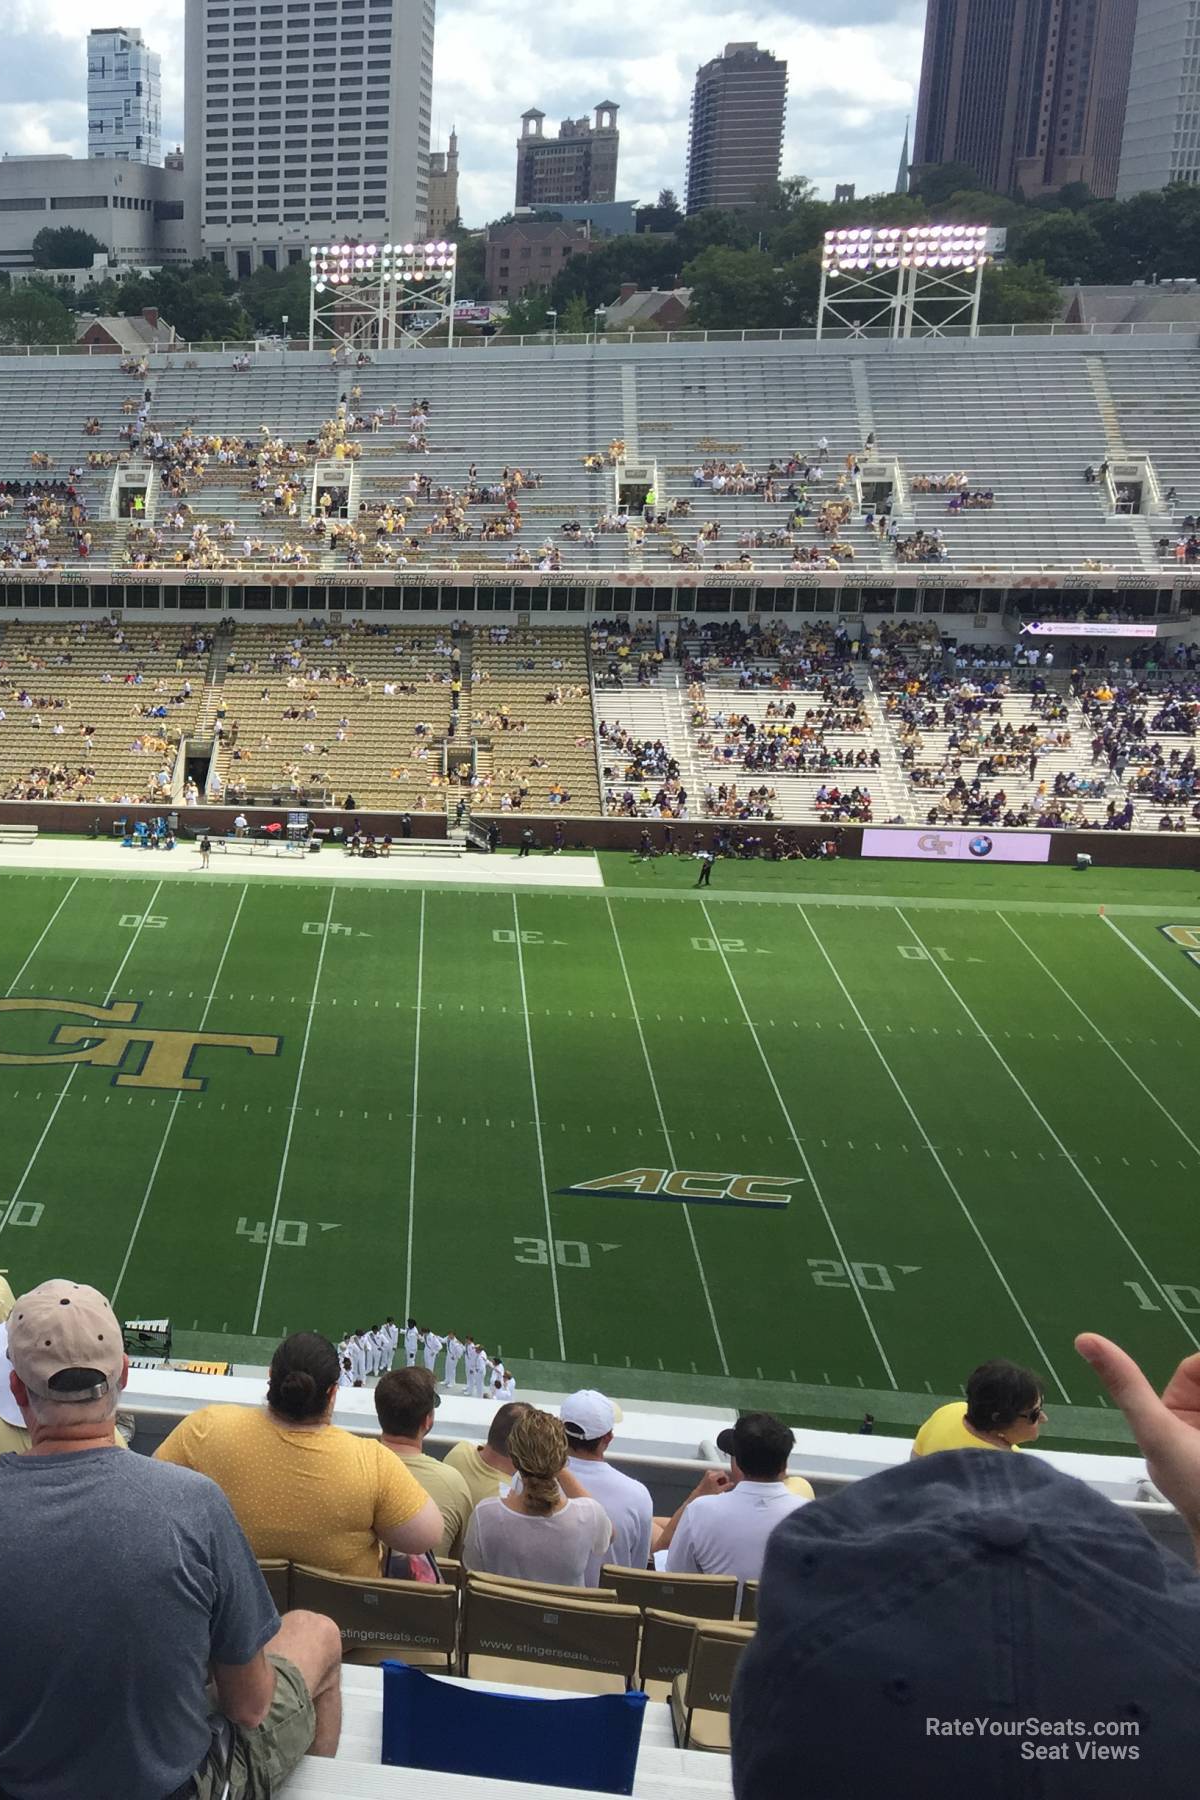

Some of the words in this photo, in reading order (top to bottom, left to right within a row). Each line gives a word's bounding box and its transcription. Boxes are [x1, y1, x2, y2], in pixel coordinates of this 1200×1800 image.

[112, 577, 162, 585] FLOWERS
[1064, 580, 1100, 588] BECK
[569, 1168, 806, 1205] ACC
[235, 1216, 309, 1247] 40
[512, 1236, 592, 1268] 30
[806, 1258, 896, 1292] 20
[1122, 1281, 1200, 1314] 10
[479, 1639, 620, 1667] www.stingerseats.com
